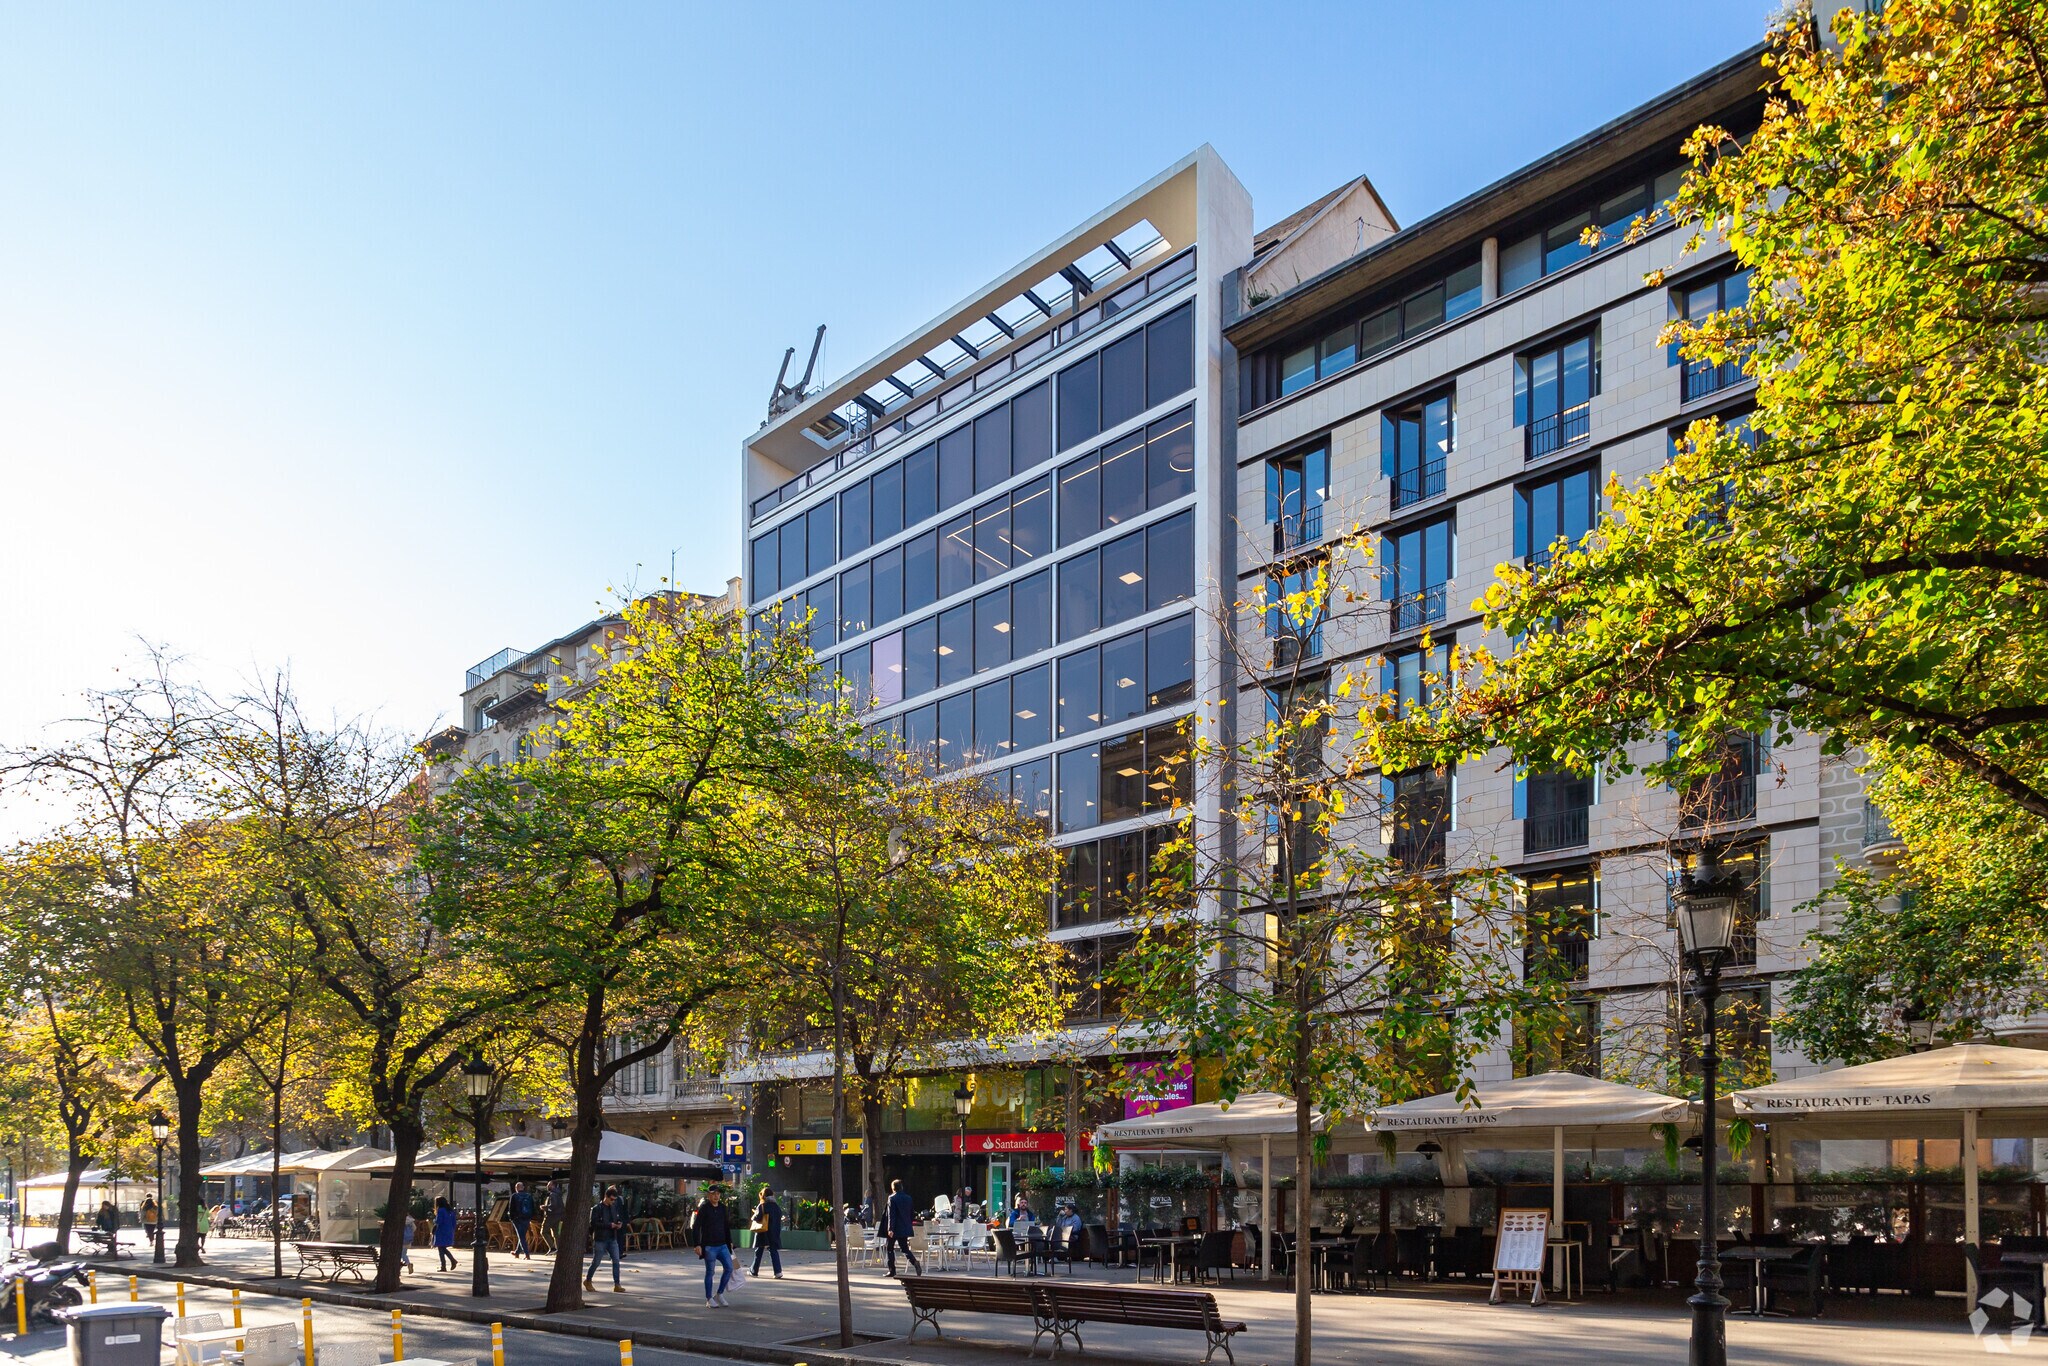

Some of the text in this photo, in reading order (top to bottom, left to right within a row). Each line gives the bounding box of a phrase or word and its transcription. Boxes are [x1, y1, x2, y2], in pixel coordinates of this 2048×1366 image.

[1767, 1094, 1931, 1108] RESTAURANTE TAPAS
[1387, 1114, 1497, 1126] RESTAURANTE TAPAS
[1114, 1126, 1193, 1137] RESTAURANTE TAPAS
[726, 1130, 744, 1155] P
[995, 1138, 1039, 1149] Santander
